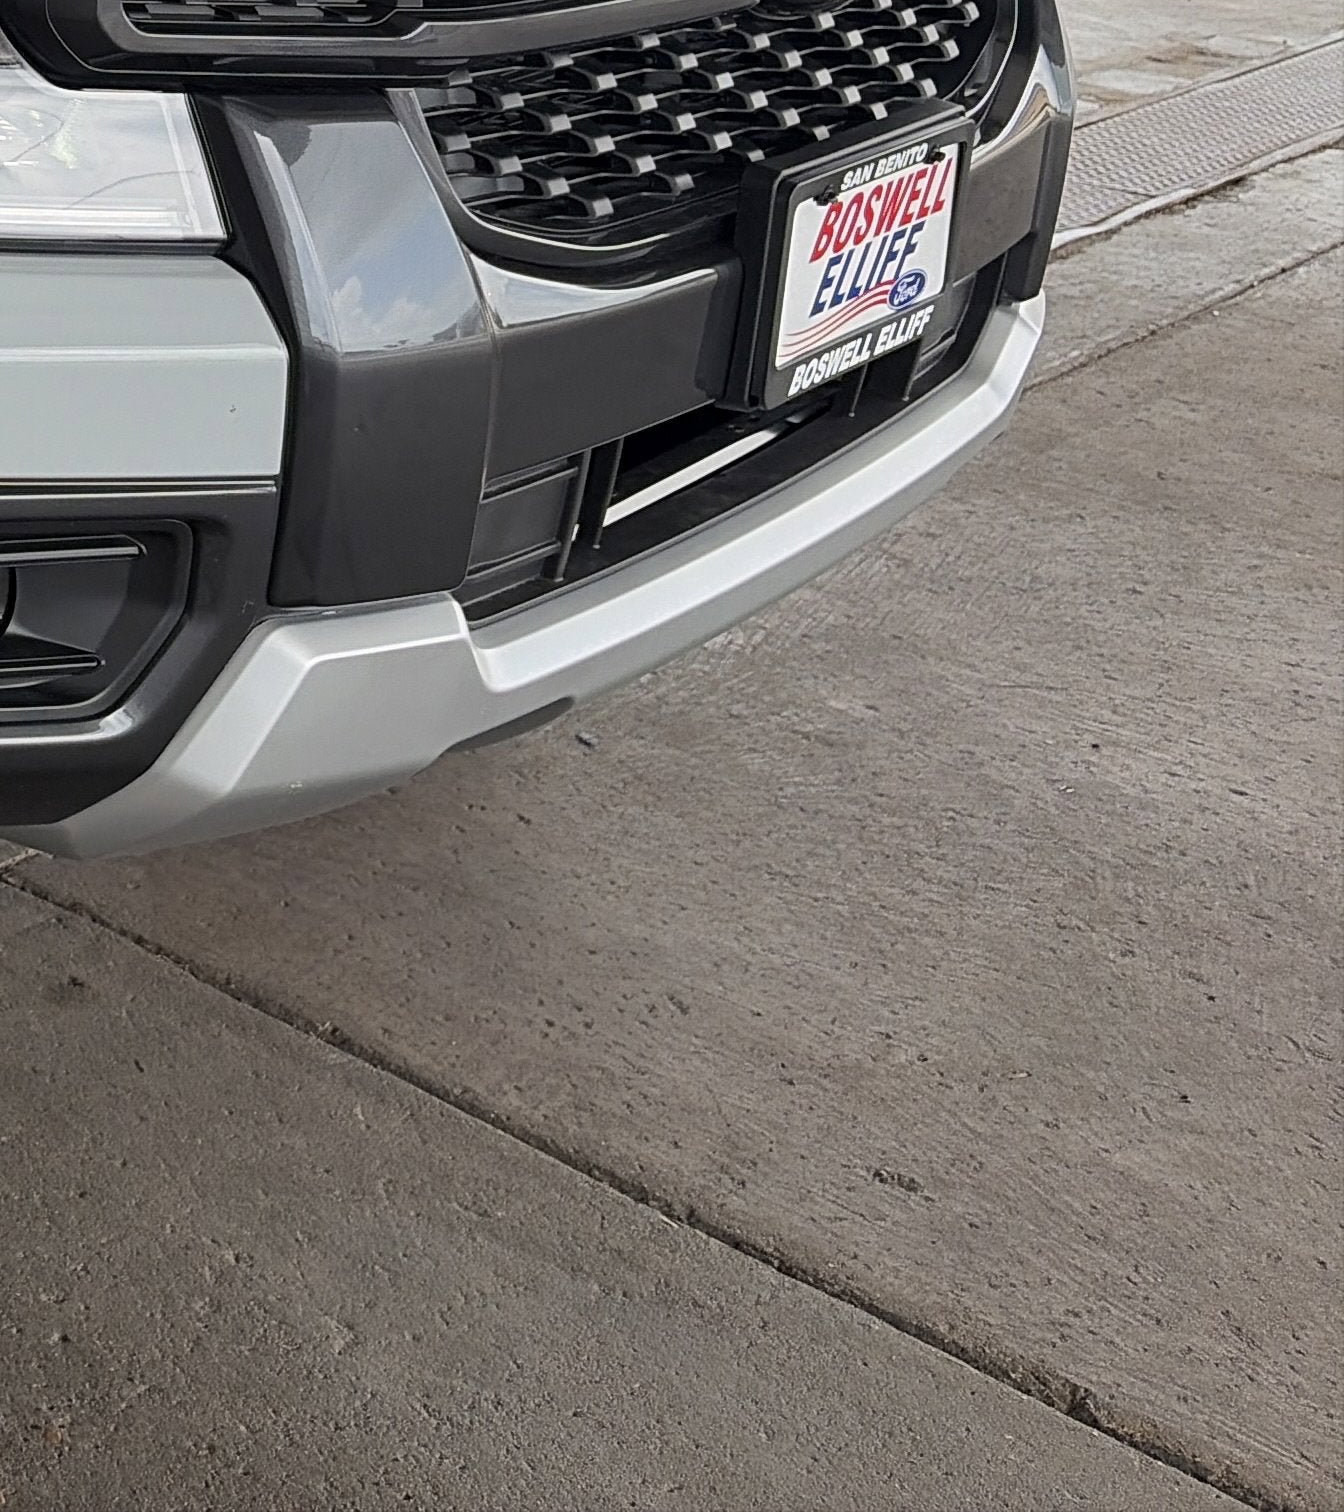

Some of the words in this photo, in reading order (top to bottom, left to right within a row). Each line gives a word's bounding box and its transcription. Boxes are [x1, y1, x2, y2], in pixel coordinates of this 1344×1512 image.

[809, 157, 953, 264] BOSWELL
[841, 161, 877, 191] SAN
[874, 142, 929, 180] BENITO
[809, 220, 926, 319] ELLIFF
[893, 274, 921, 306] Ford
[787, 332, 873, 399] BOSWELL
[873, 305, 935, 357] ELLIFF
